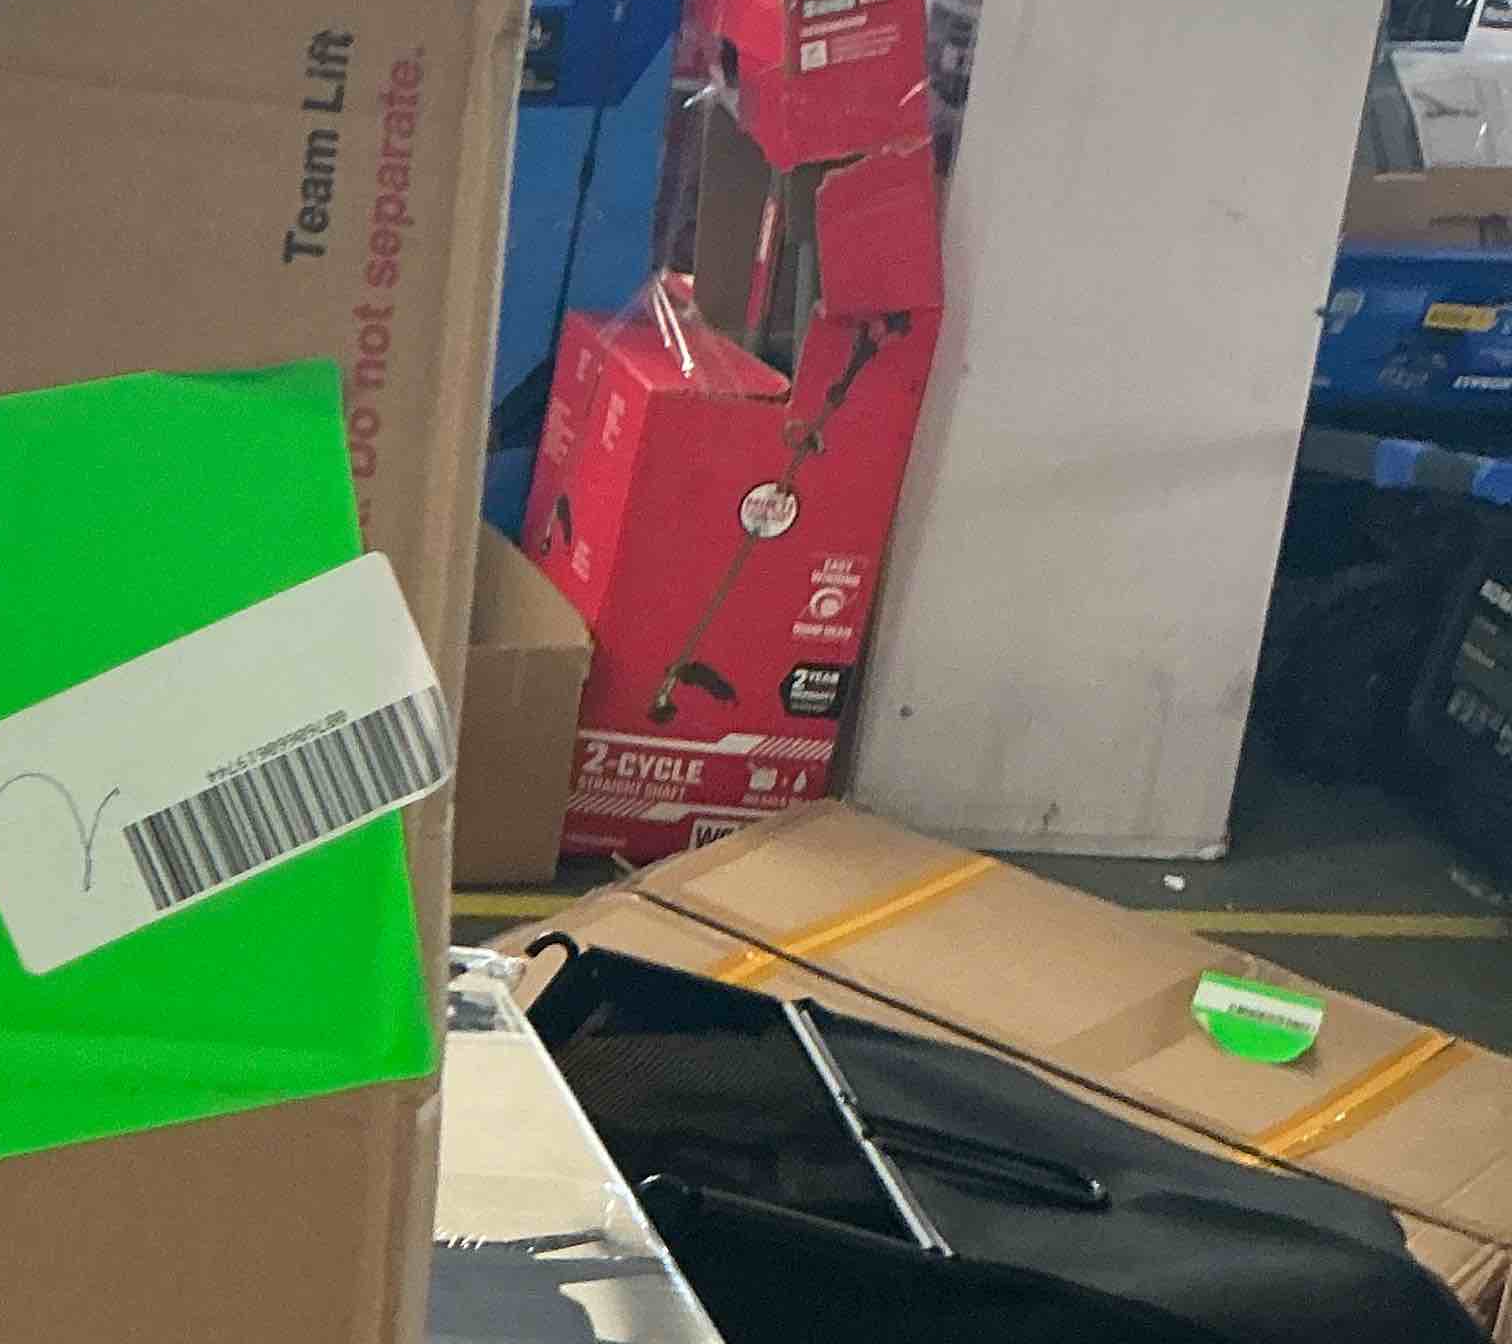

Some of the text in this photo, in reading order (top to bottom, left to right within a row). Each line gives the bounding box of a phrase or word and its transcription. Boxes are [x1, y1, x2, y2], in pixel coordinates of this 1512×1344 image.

[282, 27, 355, 264] Team Lift
[365, 46, 426, 289] separate.
[351, 303, 396, 391] not
[791, 668, 809, 691] 2
[581, 740, 705, 784] 2-CYCLE
